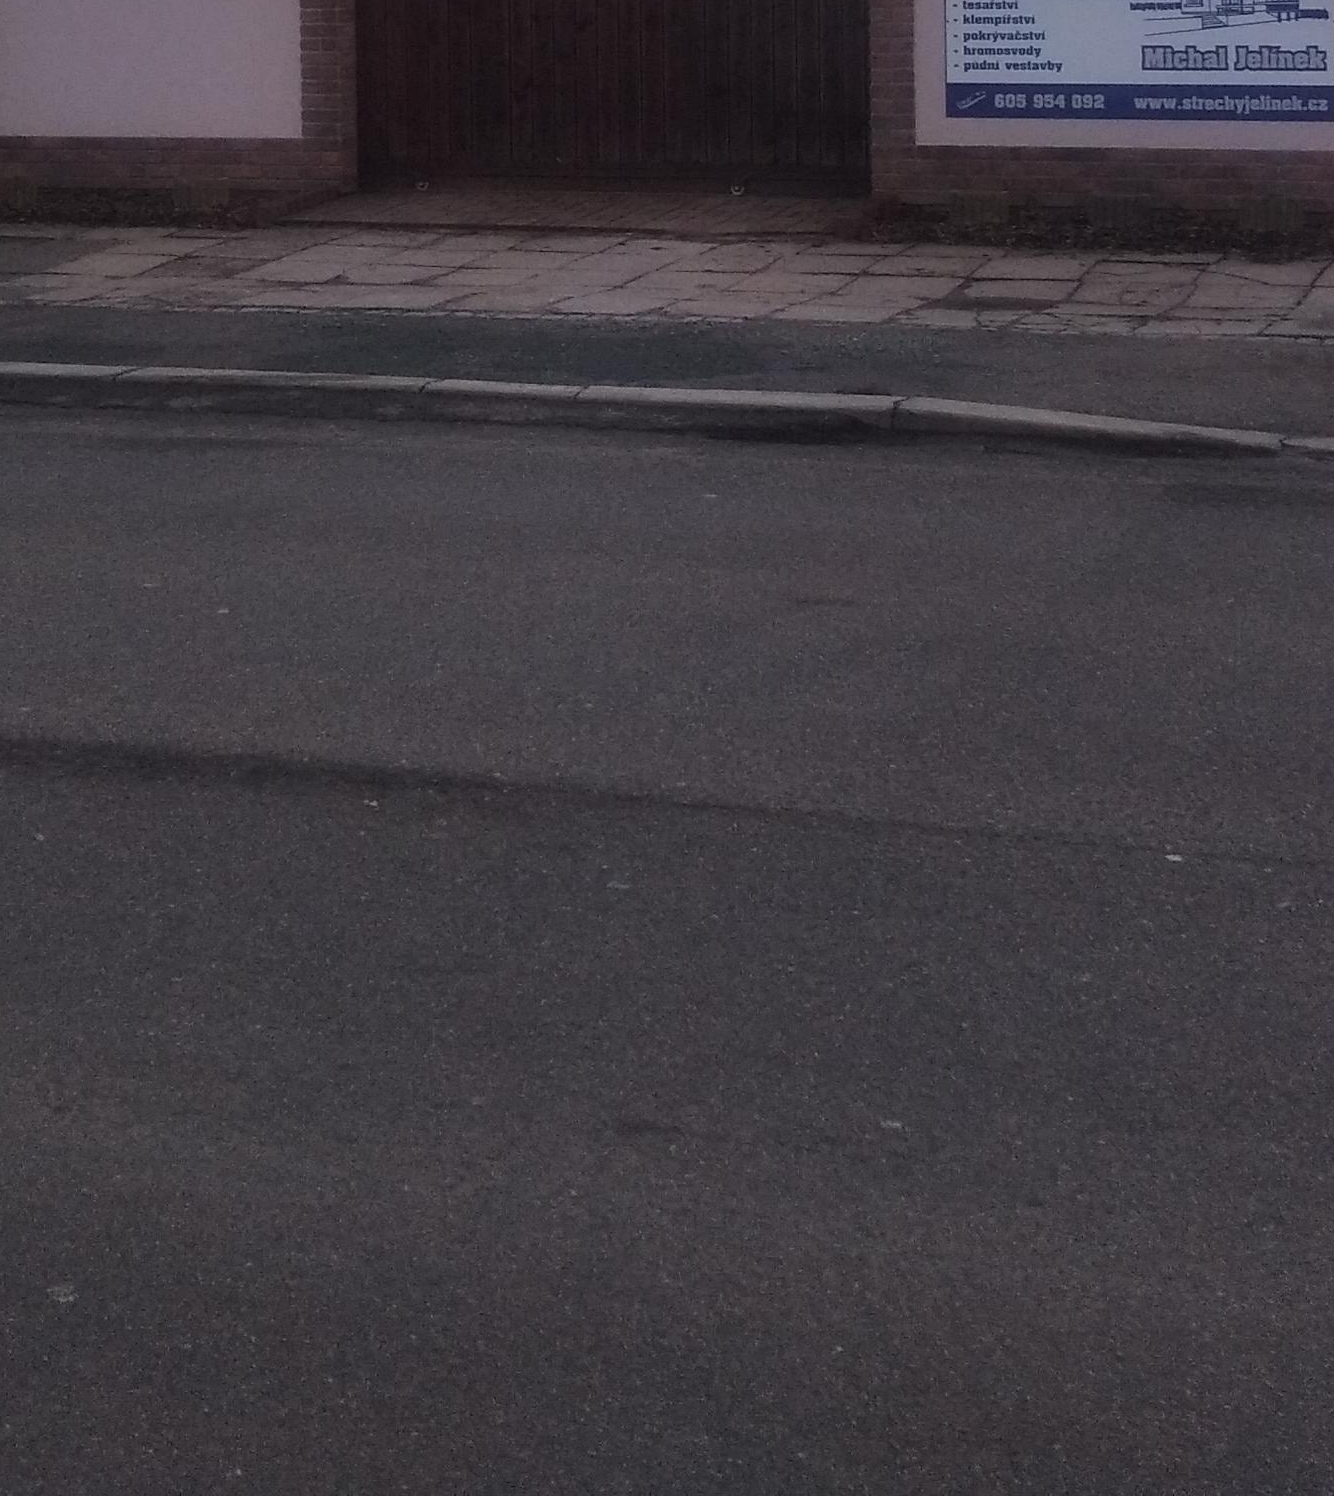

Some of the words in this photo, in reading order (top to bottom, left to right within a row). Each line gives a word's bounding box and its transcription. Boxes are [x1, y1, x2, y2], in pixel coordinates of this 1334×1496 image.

[963, 45, 1042, 57] hromosvody
[1141, 45, 1229, 71] Michal
[1005, 60, 1063, 72] vestavby
[994, 93, 1027, 109] 605
[1033, 94, 1065, 109] 954
[1072, 94, 1105, 109] 092
